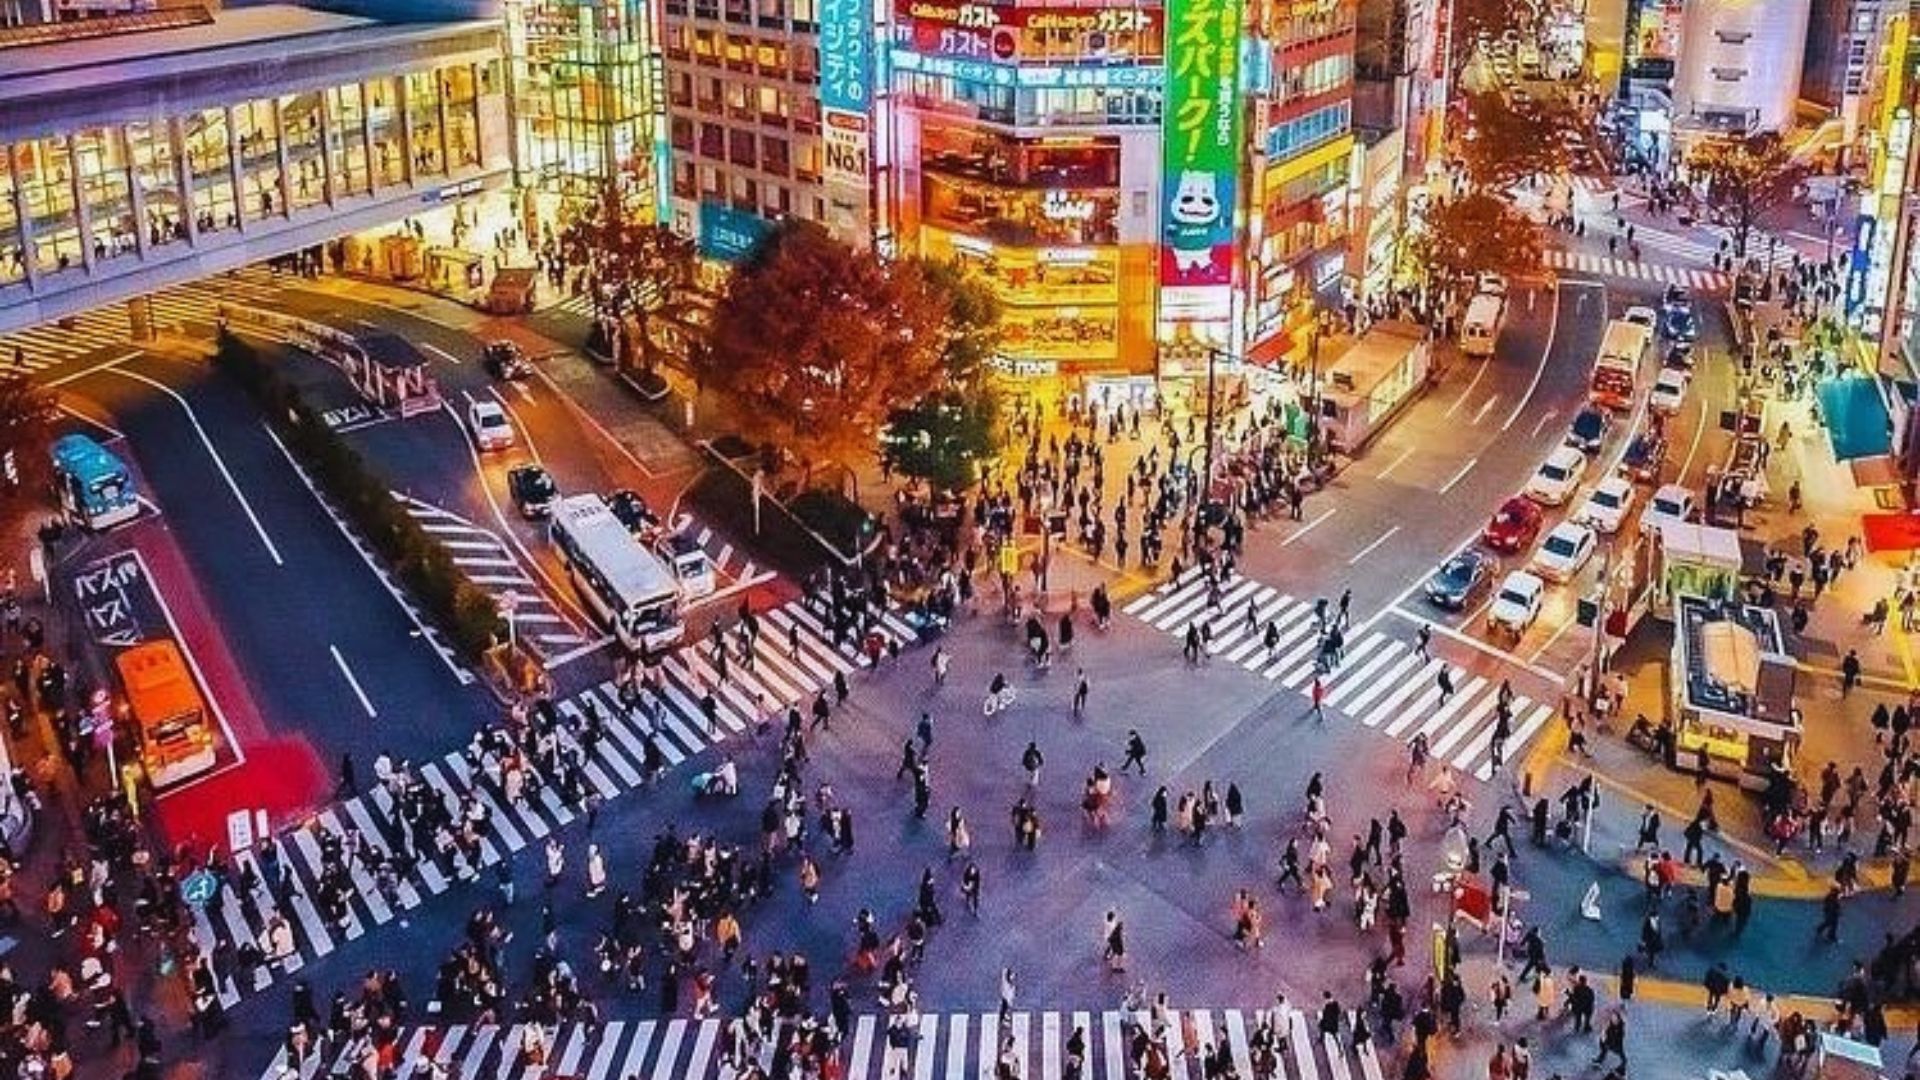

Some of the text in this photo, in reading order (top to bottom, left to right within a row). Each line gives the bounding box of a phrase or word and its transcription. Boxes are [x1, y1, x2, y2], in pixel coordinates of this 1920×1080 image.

[1097, 8, 1152, 31] ガスト
[940, 28, 989, 56] ガスト
[826, 143, 866, 176] No.1
